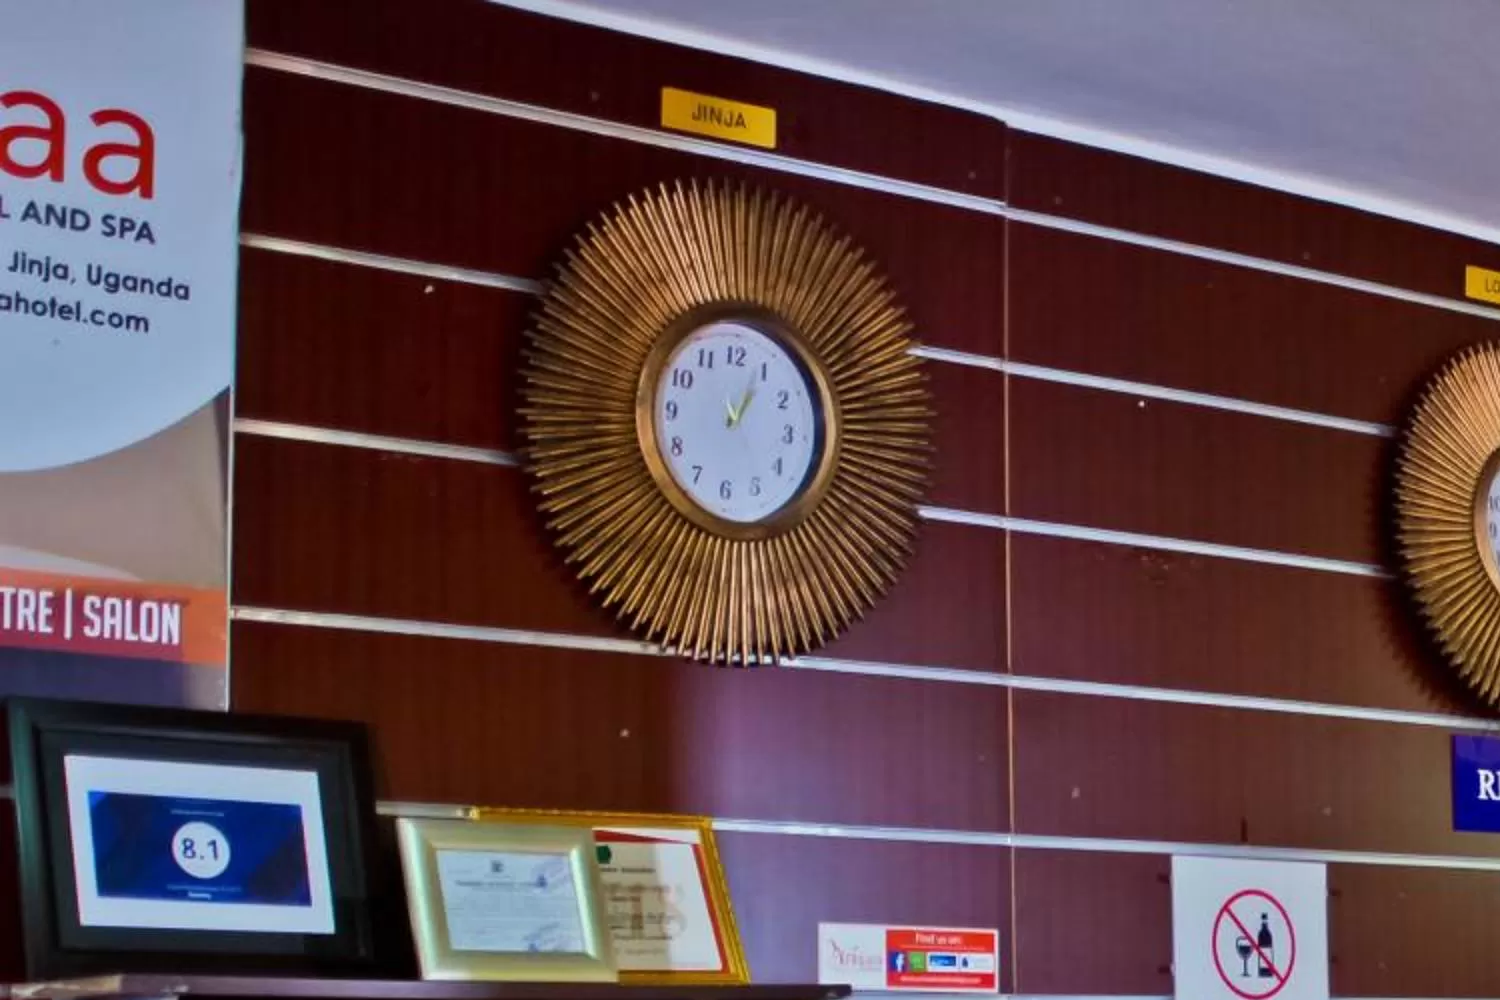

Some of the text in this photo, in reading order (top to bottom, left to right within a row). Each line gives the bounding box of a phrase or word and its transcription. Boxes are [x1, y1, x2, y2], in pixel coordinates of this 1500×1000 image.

[692, 104, 747, 128] JINJA
[21, 200, 90, 232] AND
[101, 214, 156, 245] SPA
[8, 251, 190, 301] Jinja, Uganda
[83, 596, 181, 645] SALON
[182, 838, 218, 861] 8.1
